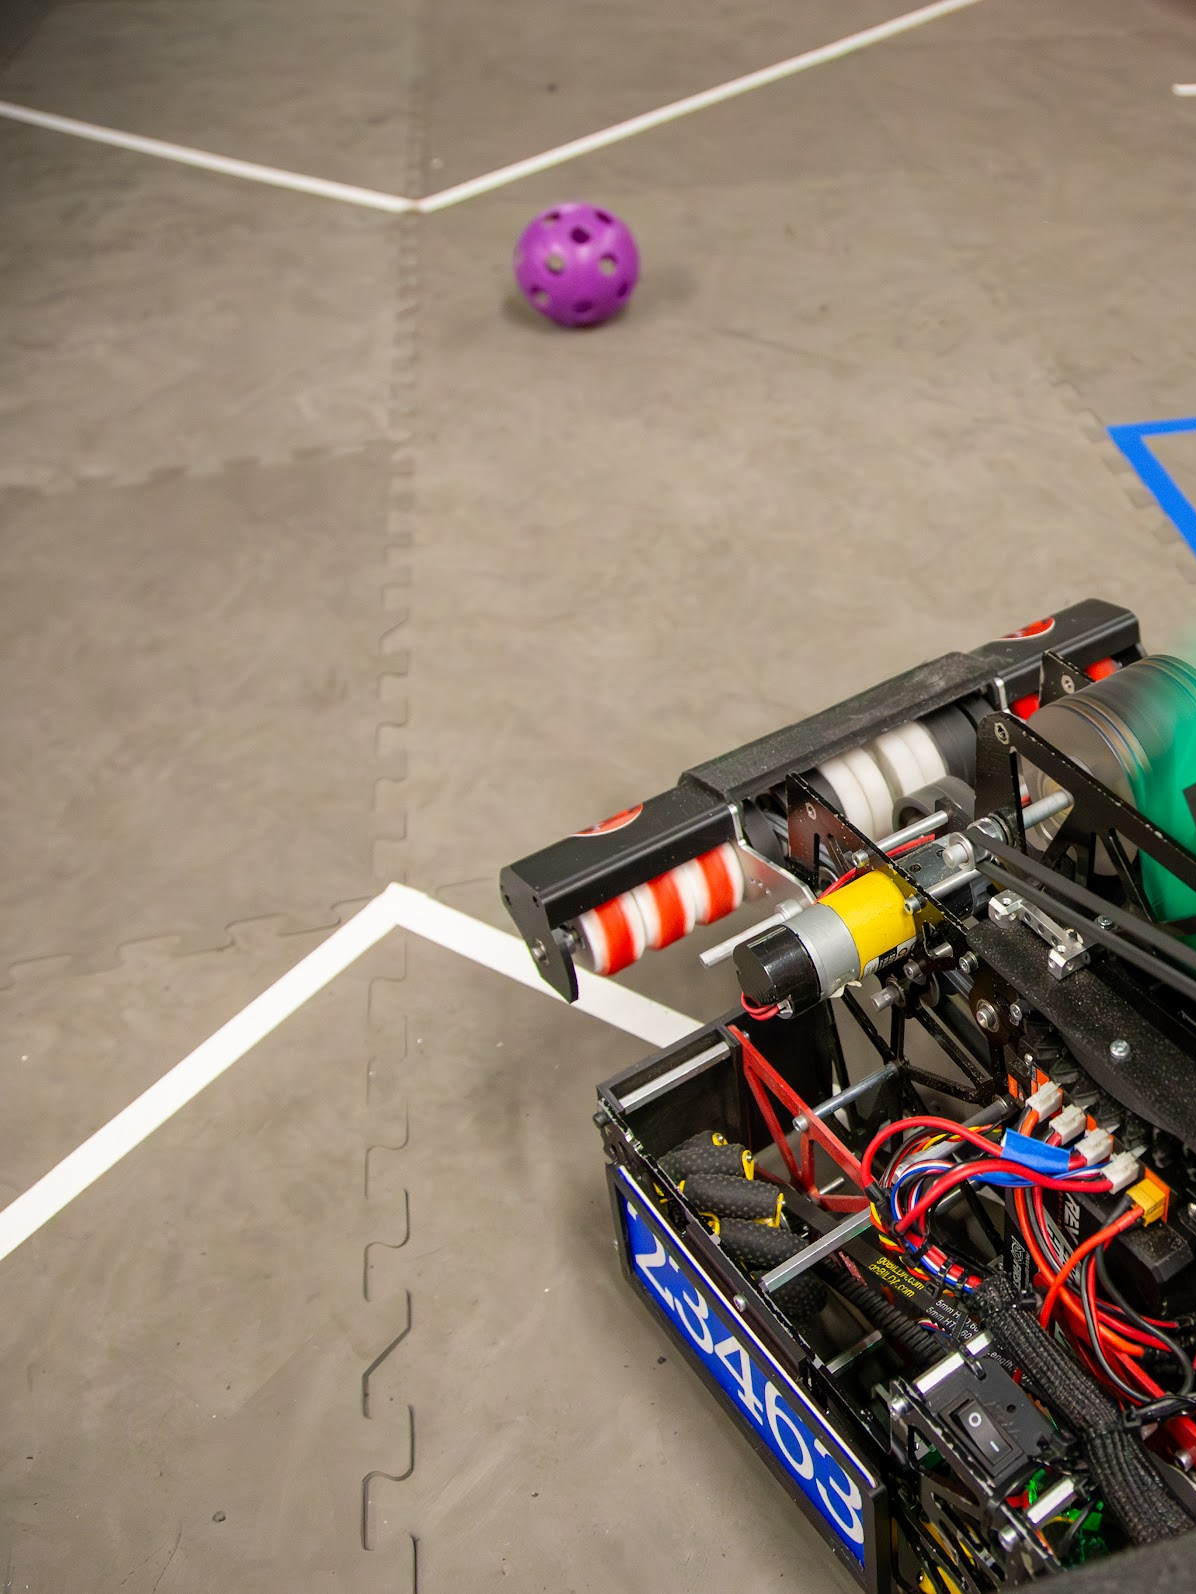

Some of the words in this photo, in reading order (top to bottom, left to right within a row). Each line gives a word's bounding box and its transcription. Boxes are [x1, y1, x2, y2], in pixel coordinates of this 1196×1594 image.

[1064, 1192, 1080, 1245] REV
[925, 1306, 945, 1322] 5mm
[935, 1299, 954, 1315] 5mm
[626, 1201, 865, 1545] 23463
